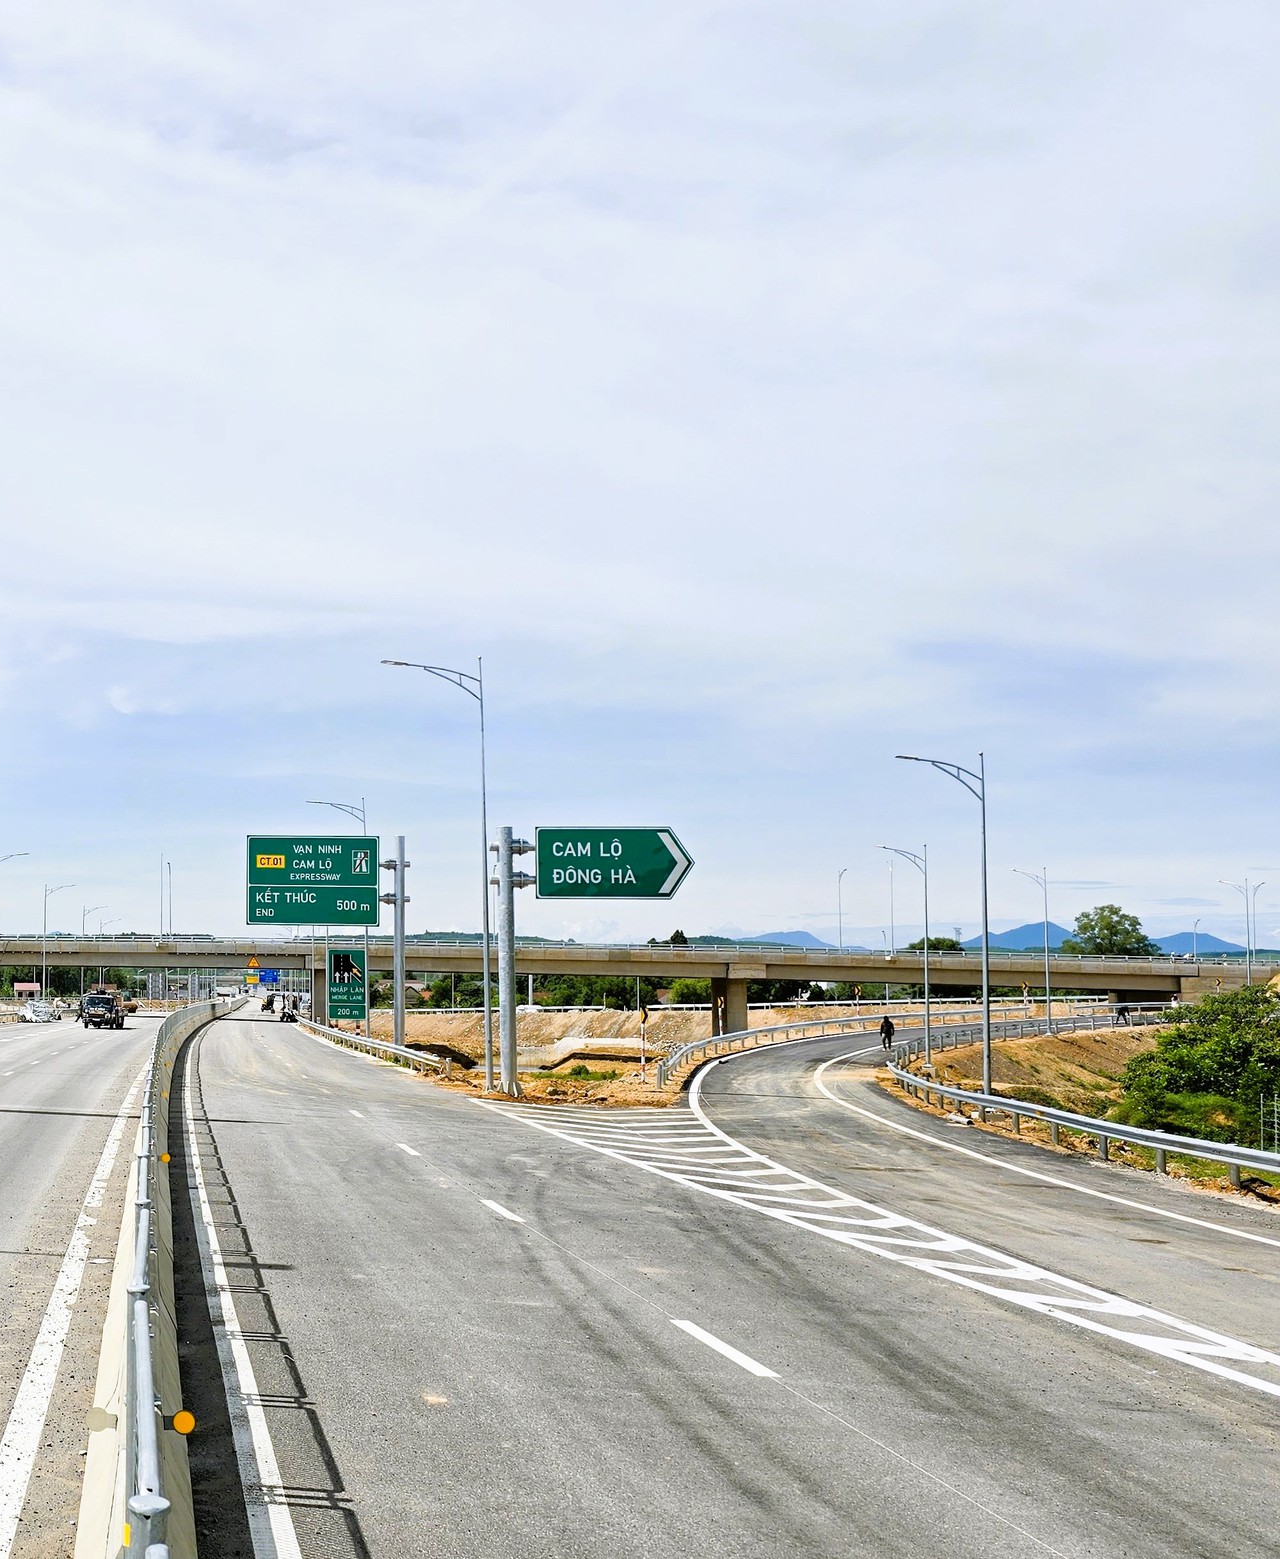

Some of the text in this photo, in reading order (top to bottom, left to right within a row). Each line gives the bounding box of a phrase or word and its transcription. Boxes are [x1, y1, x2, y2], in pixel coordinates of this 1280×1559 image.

[292, 844, 342, 856] VẠN NINH
[552, 838, 622, 860] CAM LỘ
[259, 857, 282, 866] CT.01
[292, 858, 332, 871] CAM LỘ
[290, 873, 341, 881] EXPRESSWAY
[552, 864, 637, 884] ĐÔNG HÀ
[256, 887, 317, 903] KẾT THÚC
[336, 900, 370, 911] 500 m
[256, 908, 275, 917] END
